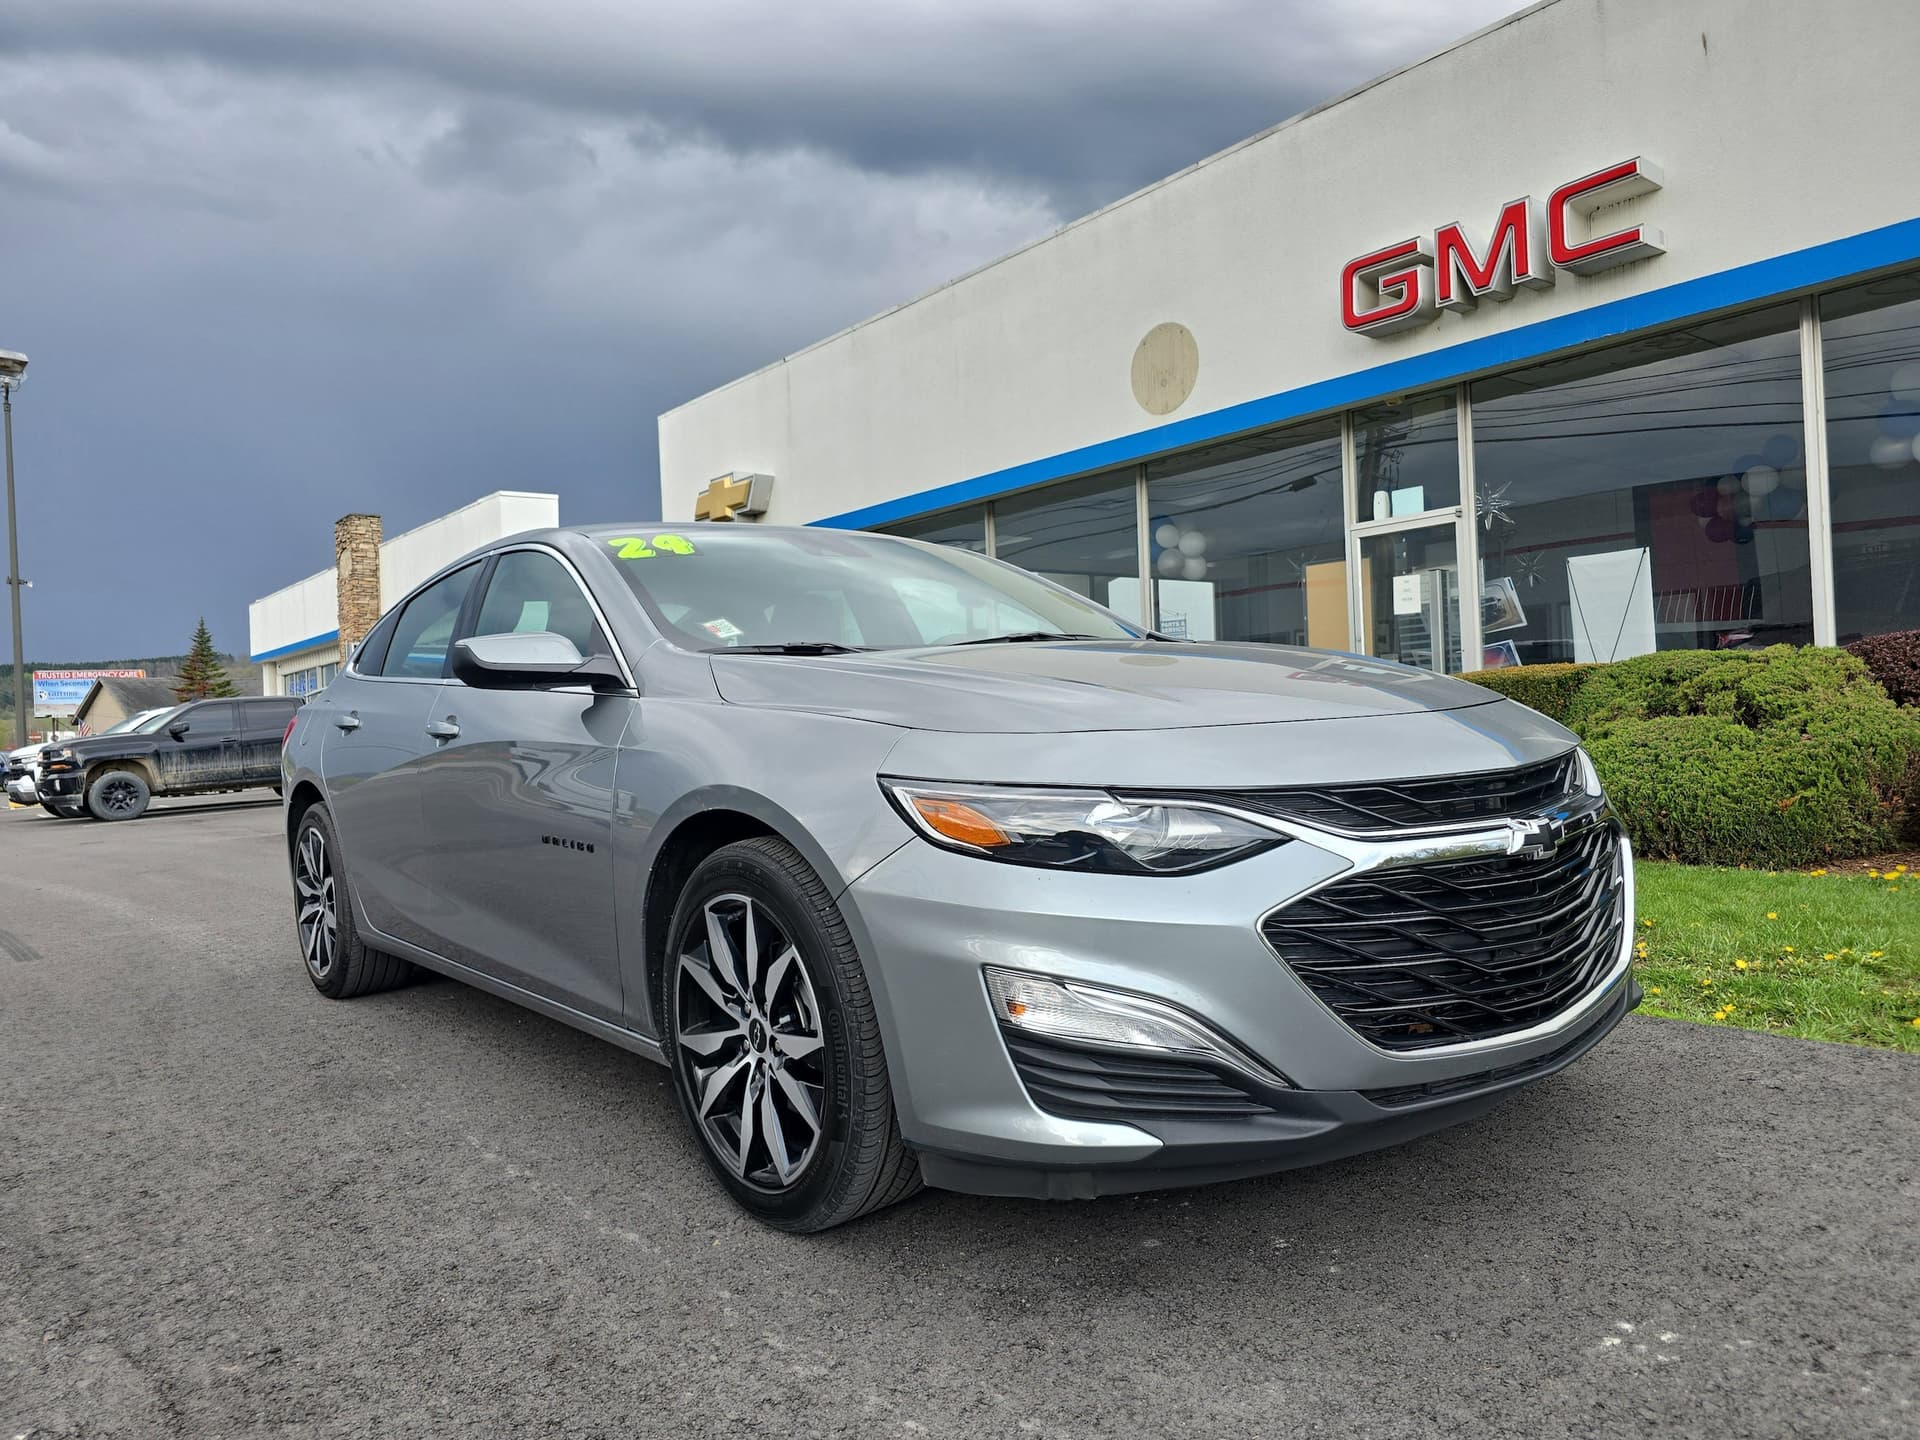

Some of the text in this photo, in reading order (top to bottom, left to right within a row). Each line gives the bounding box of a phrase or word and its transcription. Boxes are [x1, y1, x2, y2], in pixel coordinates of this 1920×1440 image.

[1340, 156, 1654, 334] GMC
[38, 670, 138, 679] TRUSTED EMERGENCY CARE
[827, 1008, 849, 1107] Continental
